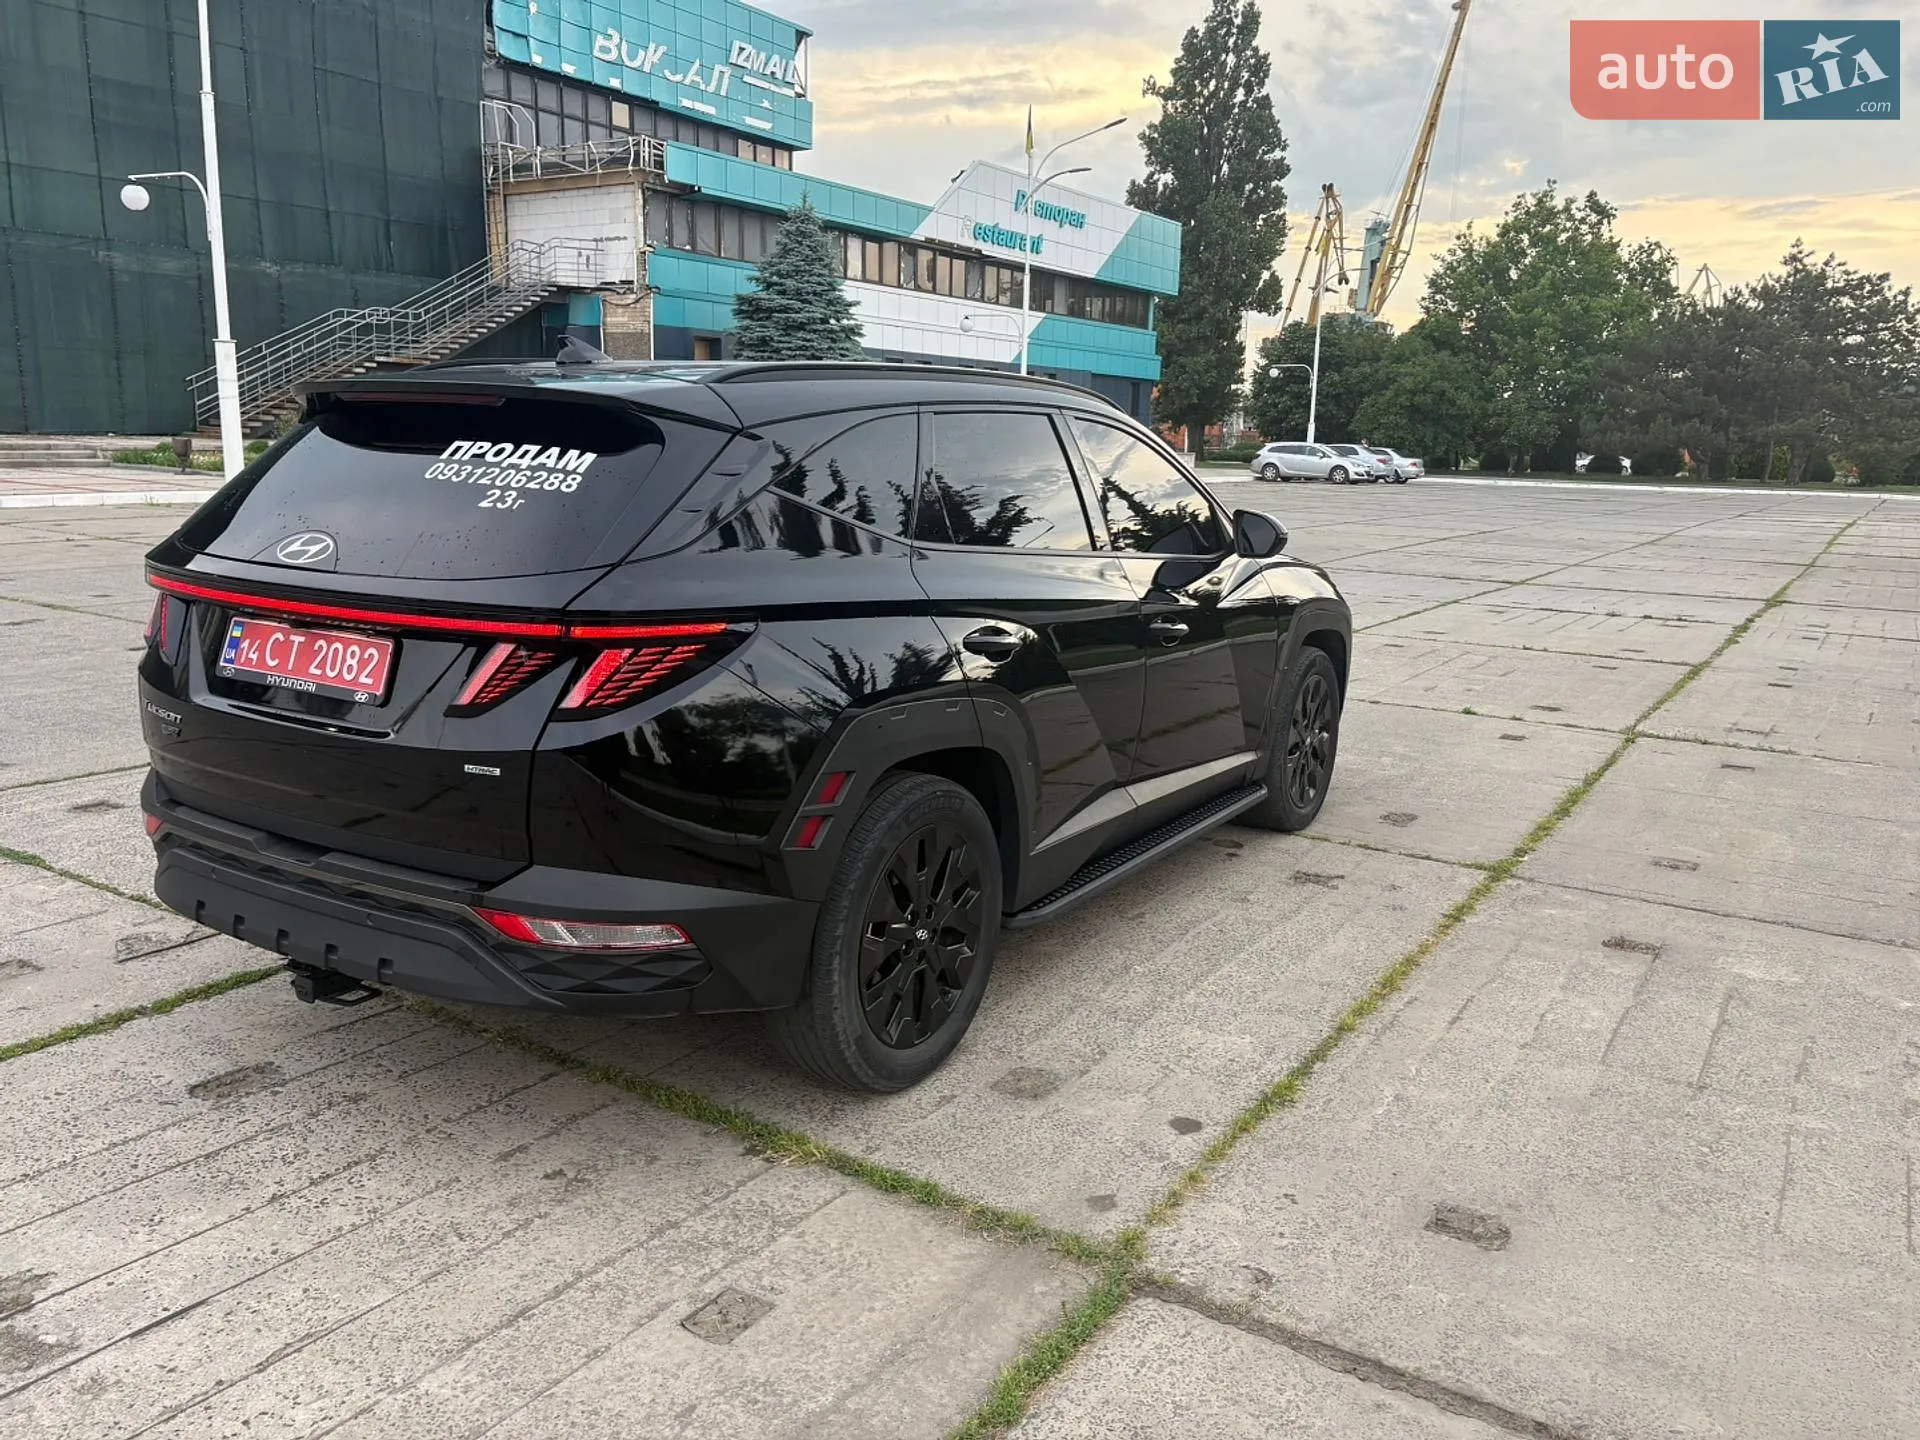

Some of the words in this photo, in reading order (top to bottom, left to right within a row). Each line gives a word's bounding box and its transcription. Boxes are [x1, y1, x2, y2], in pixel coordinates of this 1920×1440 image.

[439, 440, 598, 473] ПРОДАМ
[424, 462, 582, 493] 0931206288
[308, 639, 379, 685] 2082
[266, 675, 316, 693] HYUNDAI
